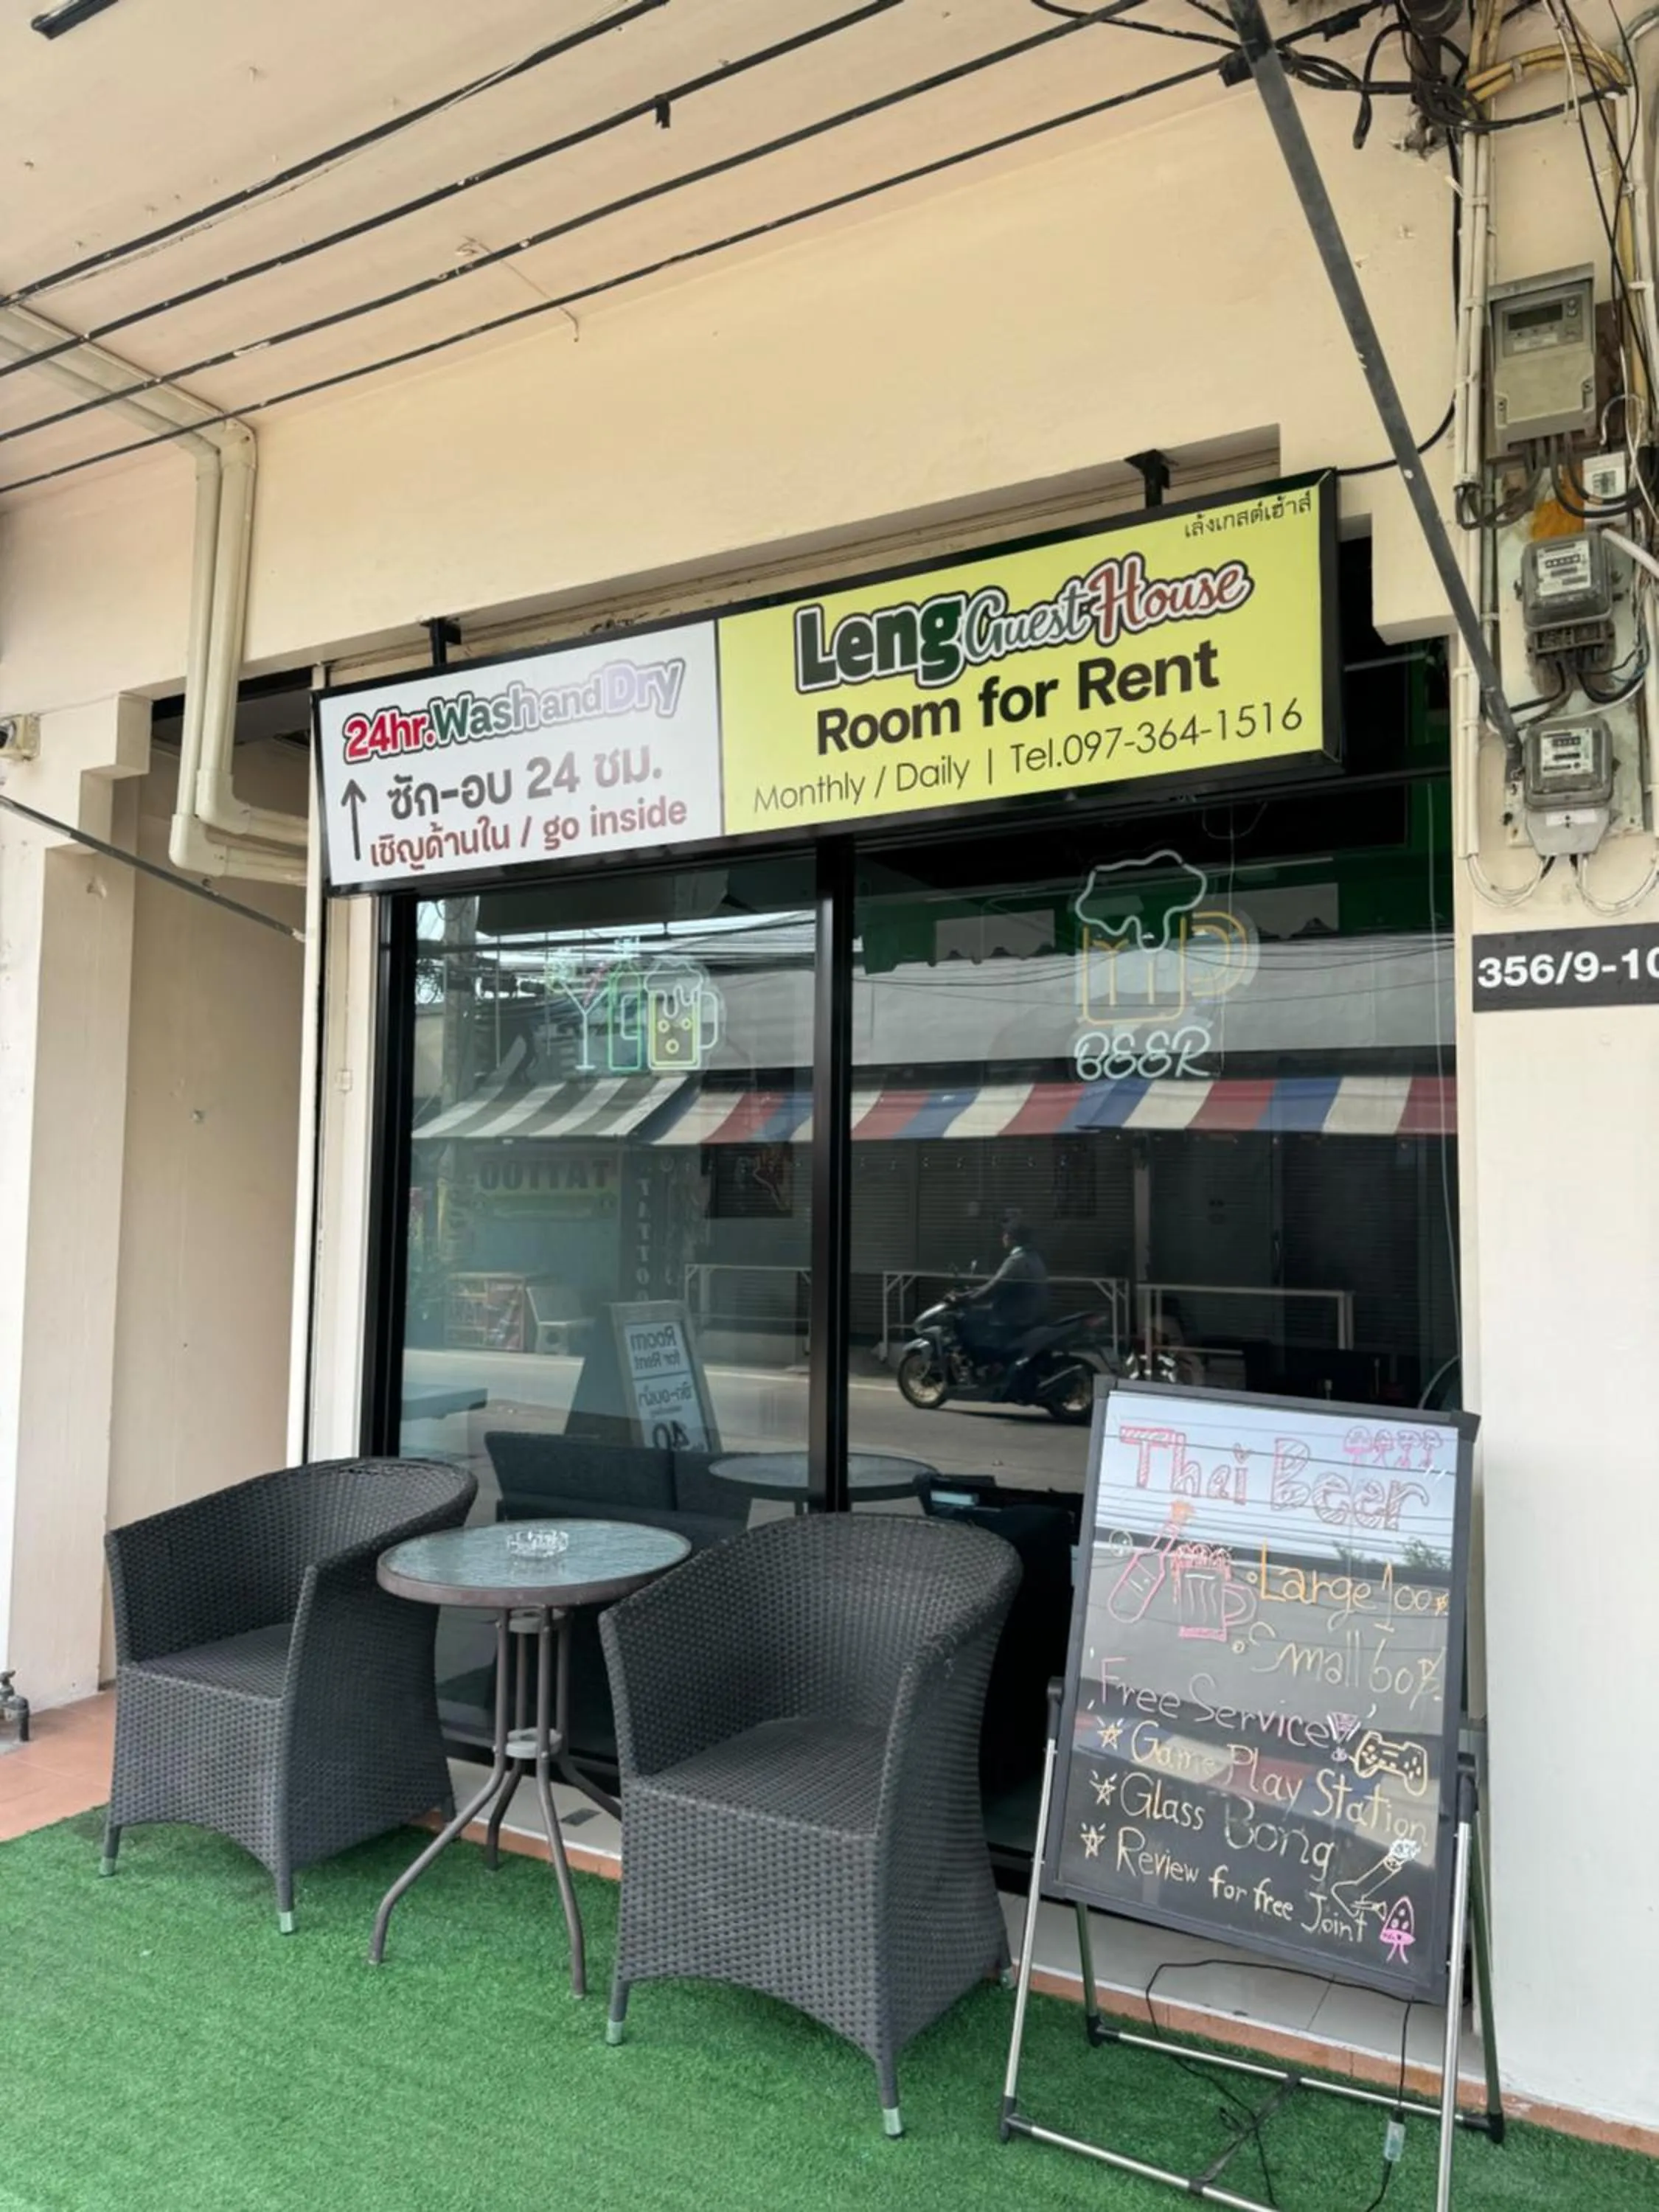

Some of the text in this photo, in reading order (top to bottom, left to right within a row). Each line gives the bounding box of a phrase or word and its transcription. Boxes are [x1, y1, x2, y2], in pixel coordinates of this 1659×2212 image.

[796, 553, 1253, 691] Leng Guest House
[818, 639, 1220, 756] Room for Rent
[387, 745, 663, 821] ซัก-อบ 24 ชม.
[754, 762, 865, 813] Monthly
[896, 754, 971, 795] Daily
[1010, 697, 1304, 775] Tel.097-364-1516
[371, 815, 511, 871] เชิญด้านใน
[543, 815, 580, 851] go
[590, 796, 688, 838] inside
[1074, 1025, 1211, 1081] BEER
[1119, 1425, 1430, 1531] Thai Beer
[1260, 1536, 1377, 1632] Large
[1100, 1658, 1330, 1747] Free Service
[1249, 1621, 1359, 1688] Small
[1119, 1772, 1335, 1882] Glass Bong
[1130, 1719, 1429, 1847] Game Play Station
[1115, 1826, 1368, 1944] Review for free Joint
